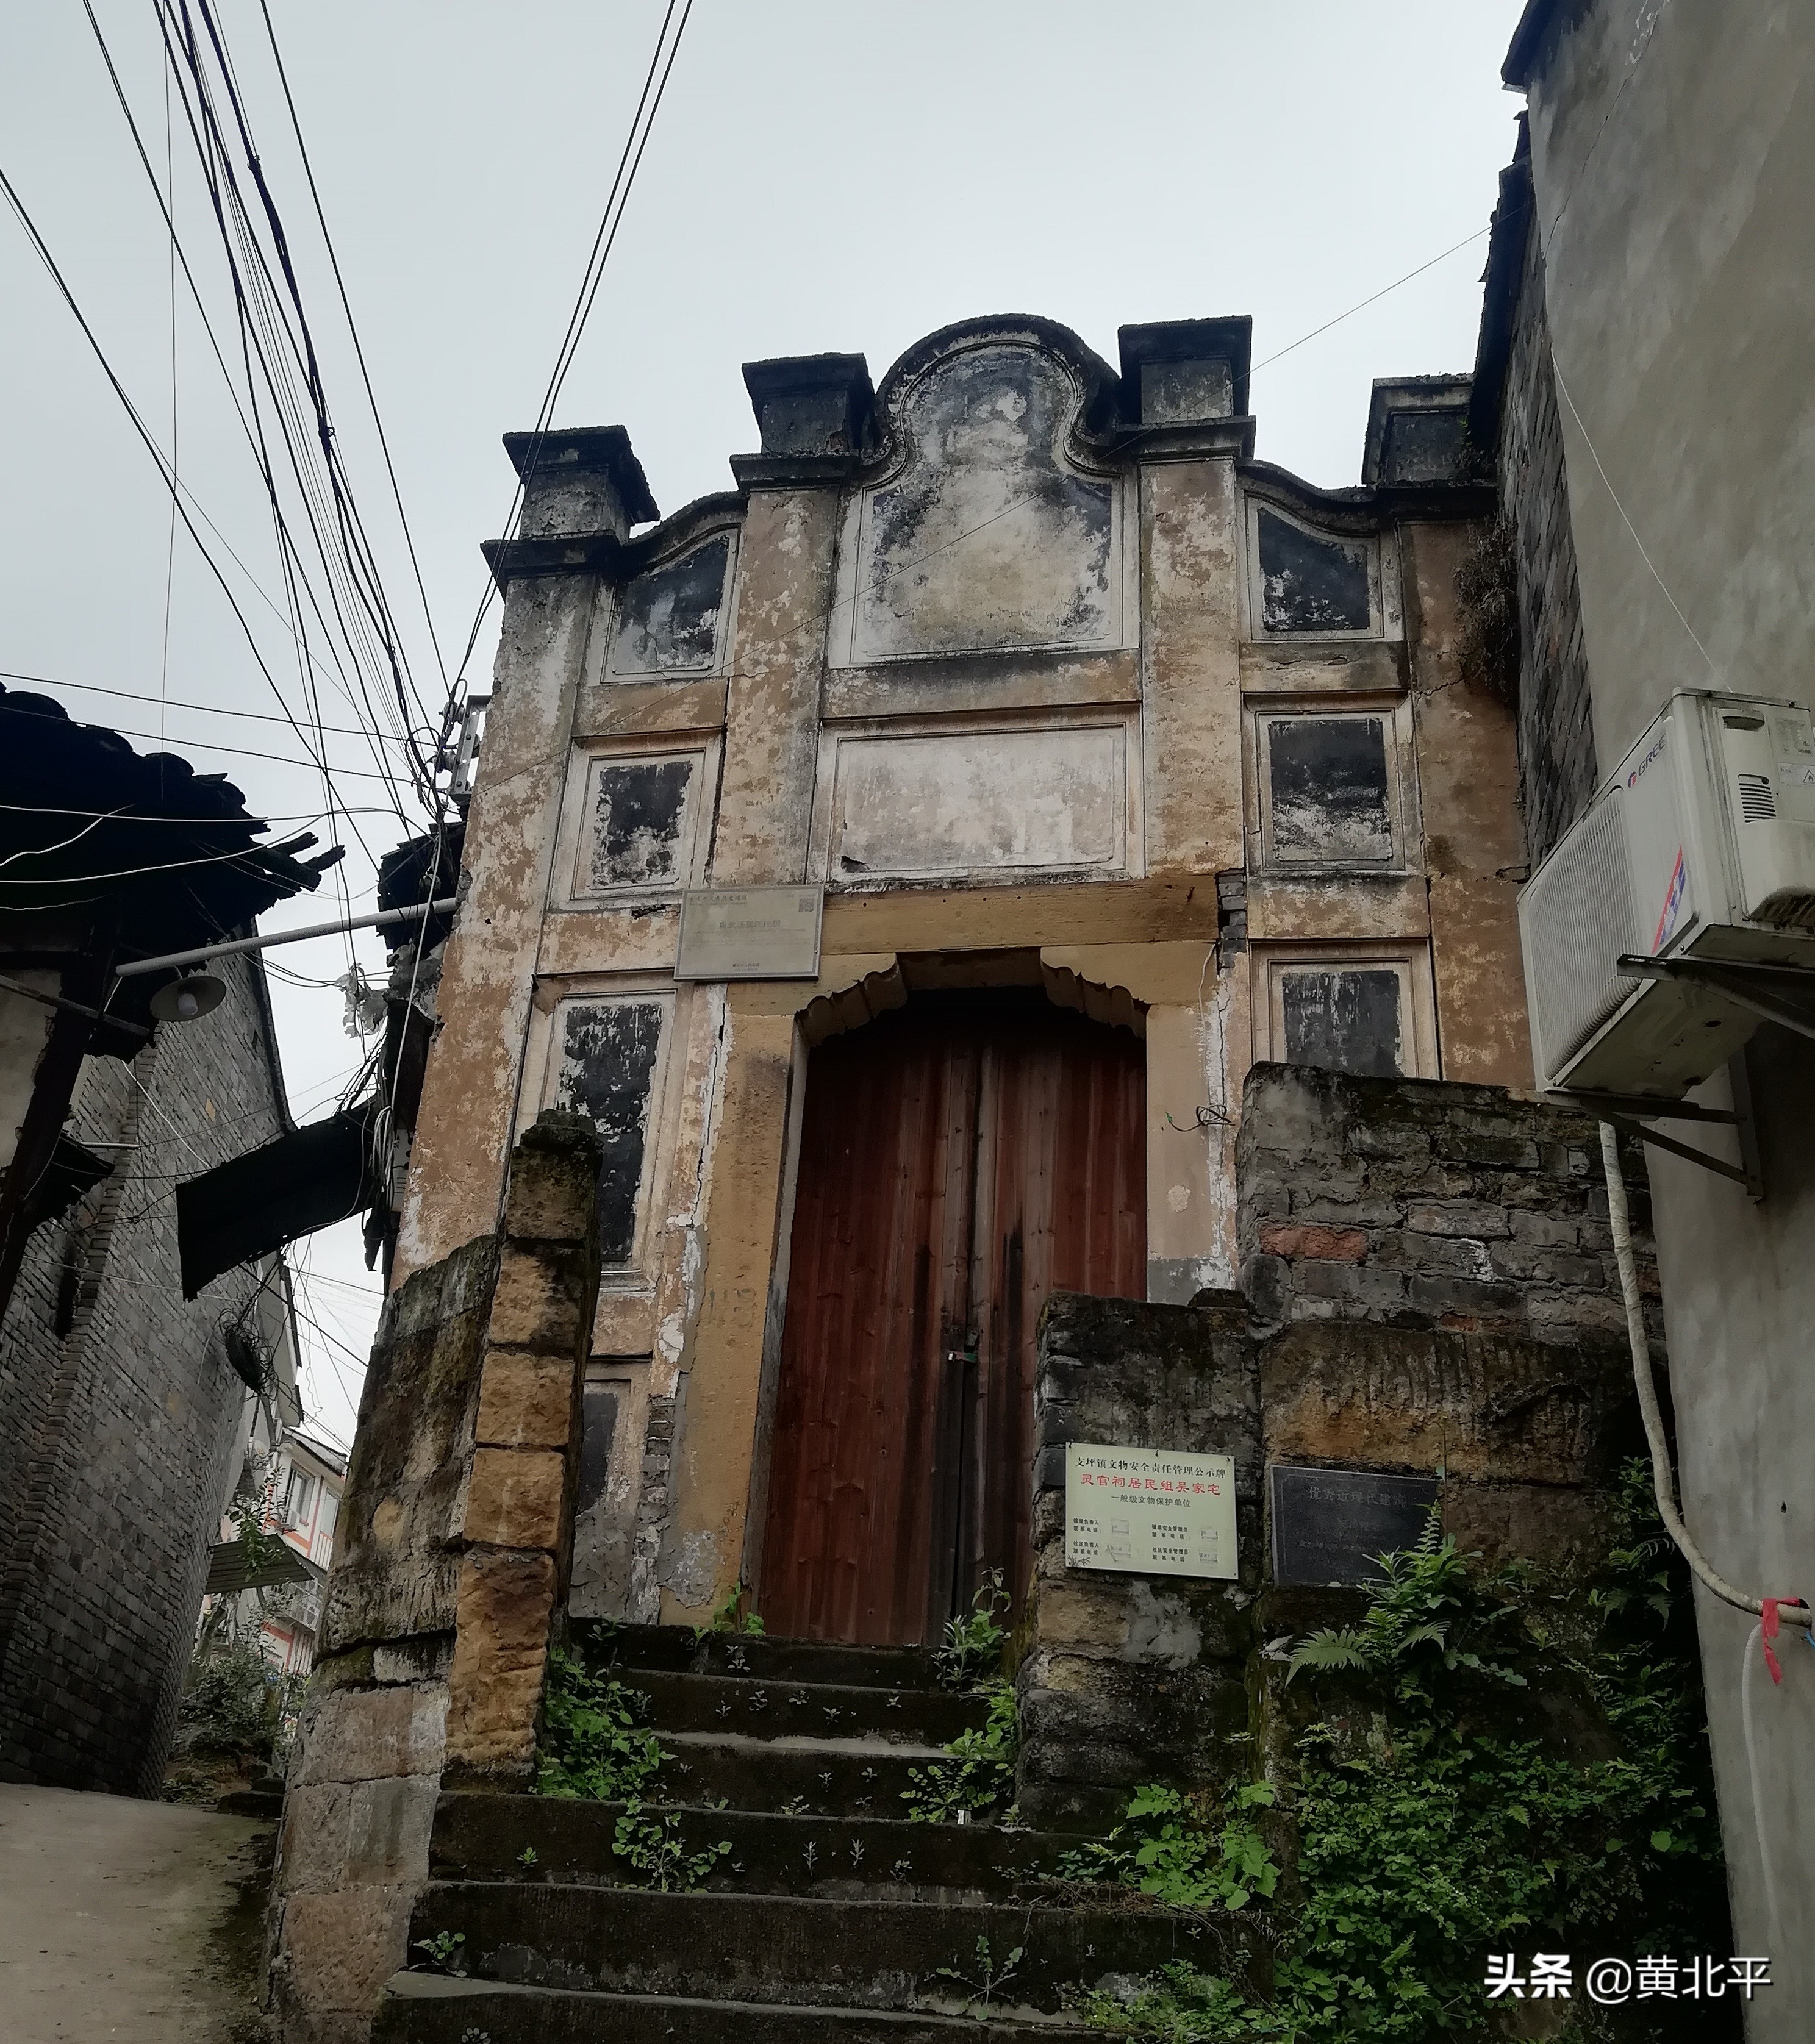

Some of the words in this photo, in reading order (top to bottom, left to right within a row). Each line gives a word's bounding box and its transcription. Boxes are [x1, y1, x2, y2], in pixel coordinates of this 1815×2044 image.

[1638, 734, 1666, 776] GREE
[1076, 1457, 1226, 1479] 支坪镇文物安全责任管理公示牌
[1081, 1473, 1221, 1495] 灵官祠居民组吴家宅
[1111, 1494, 1191, 1507] 一般级文物保护单位
